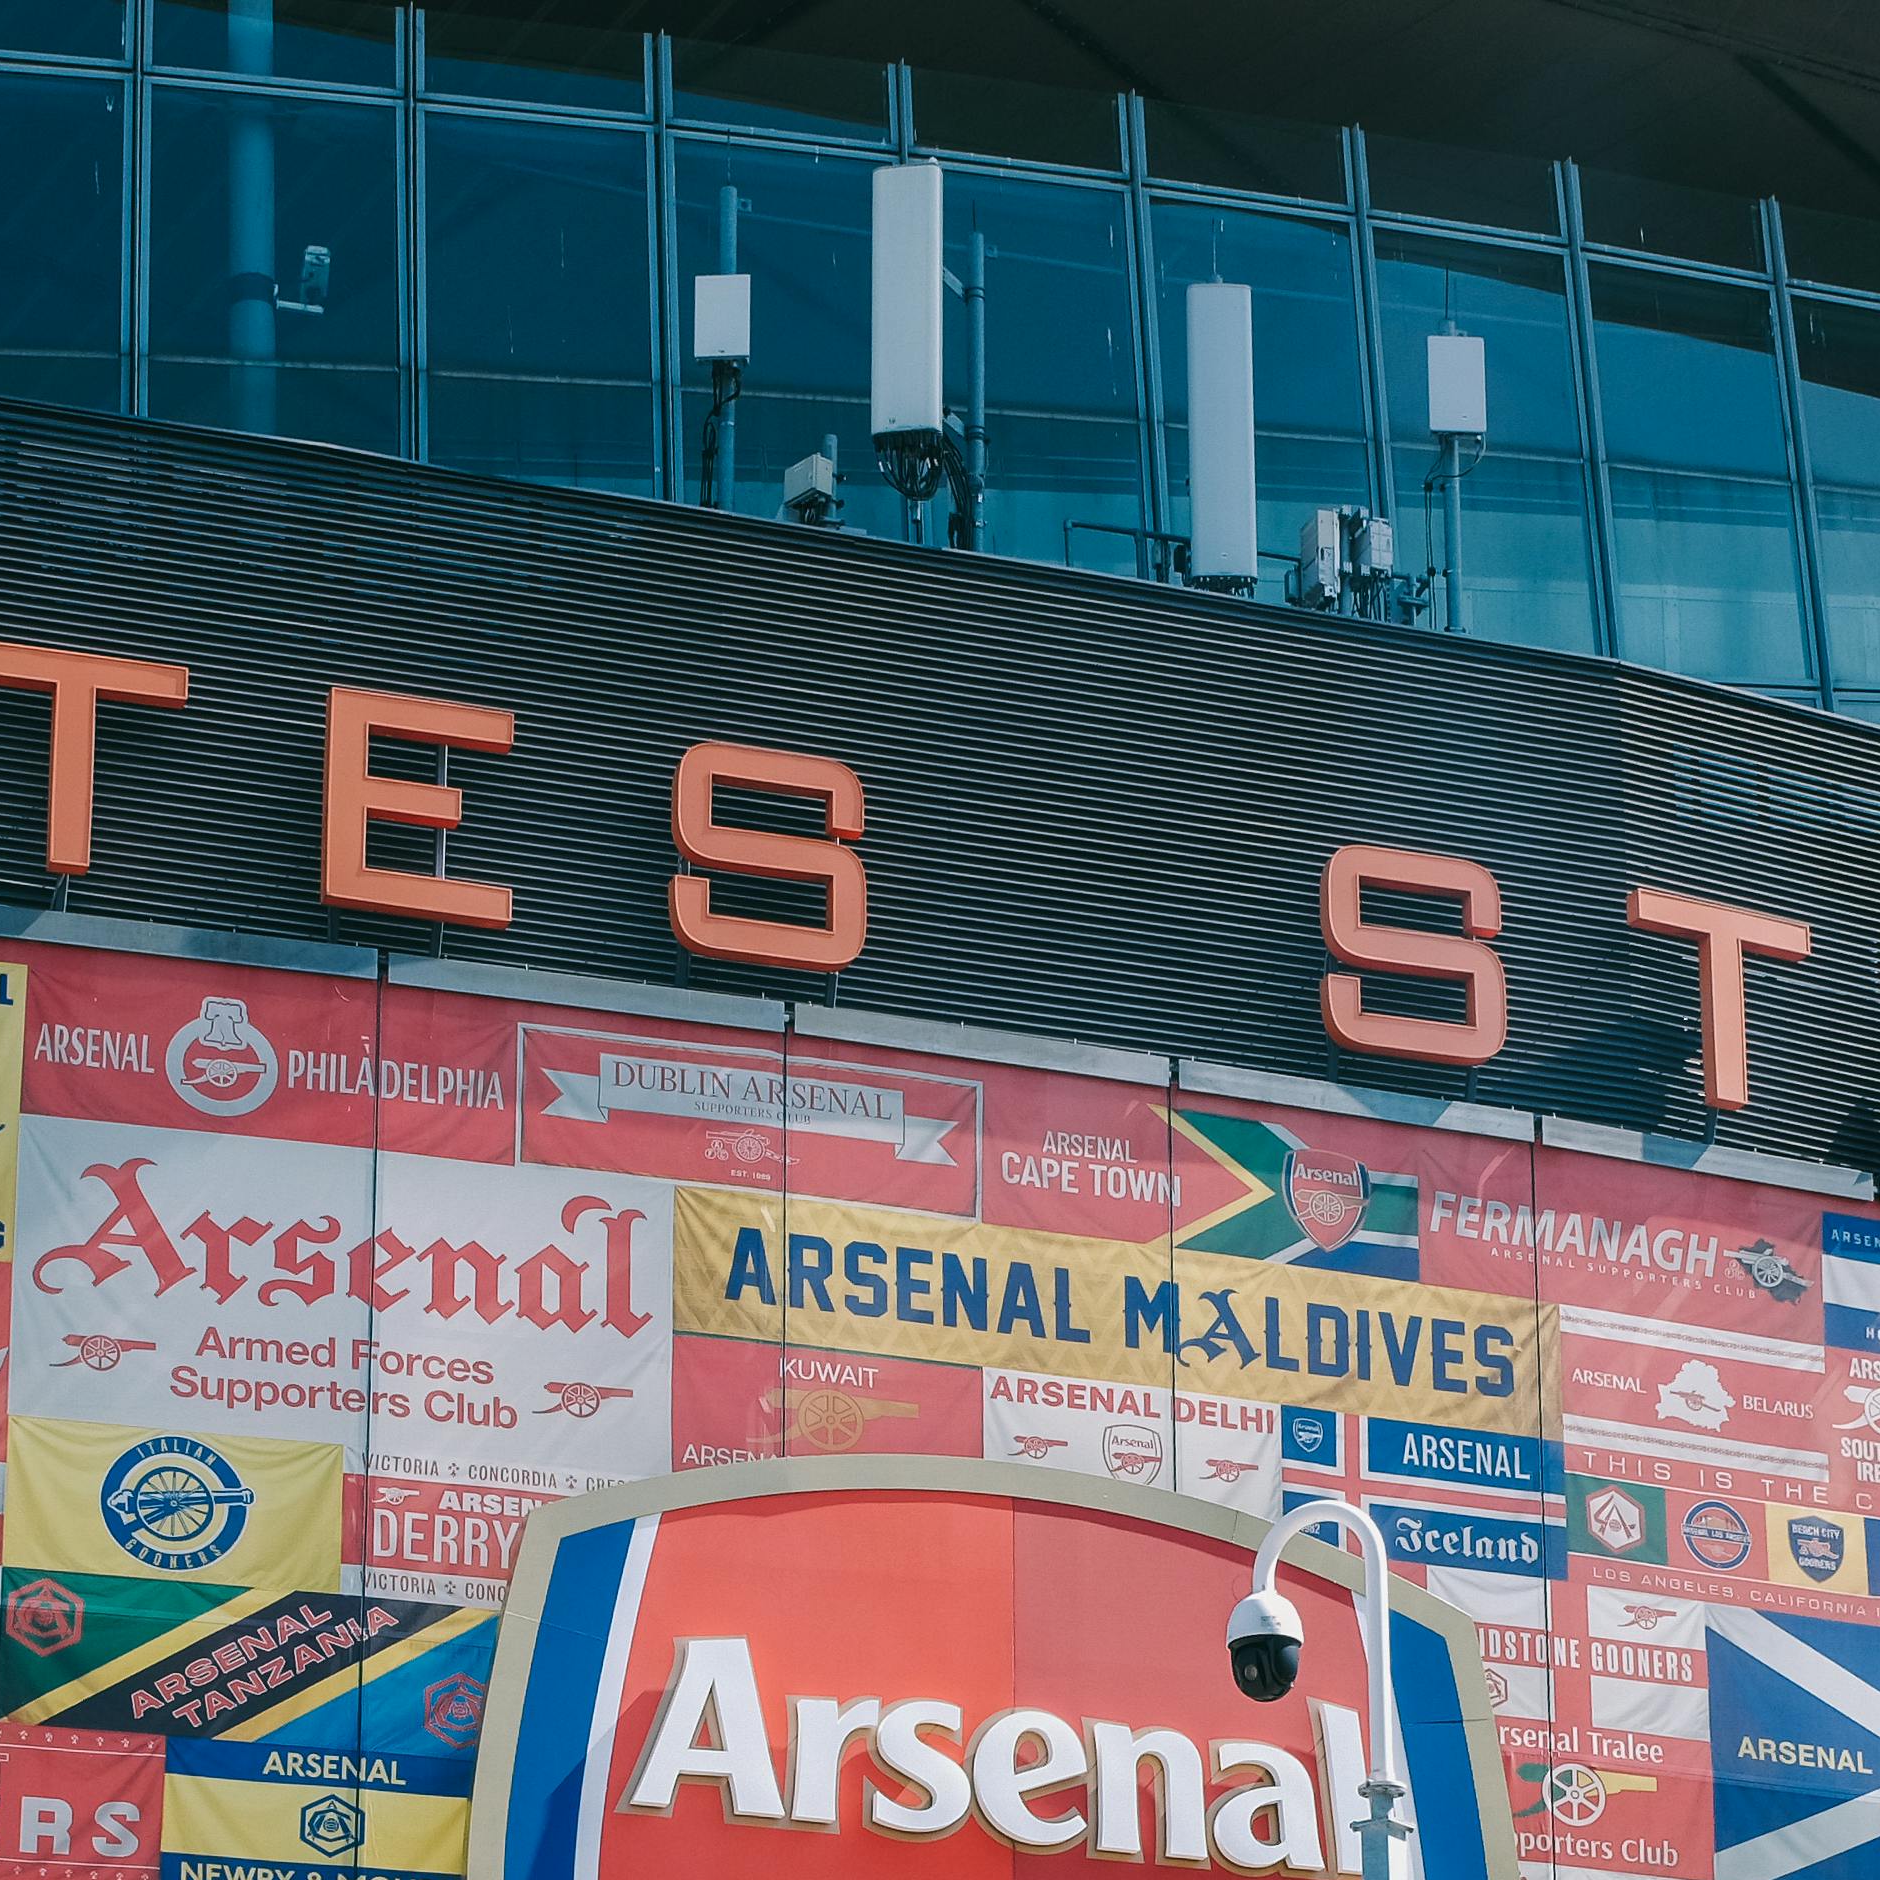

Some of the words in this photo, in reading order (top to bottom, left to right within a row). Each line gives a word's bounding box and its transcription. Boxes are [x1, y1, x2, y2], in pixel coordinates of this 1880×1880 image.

[34, 1022, 154, 1075] ARSENAL
[288, 1049, 504, 1111] PHILADELPHIA
[1042, 1129, 1138, 1161] ARSENAL
[1001, 1153, 1078, 1192] CAPE
[1086, 1164, 1181, 1206] TOWN
[32, 1156, 652, 1337] Arsenal
[1431, 1190, 1718, 1276] FERMANAGH
[724, 1226, 1091, 1344] ARSENAL
[1122, 1274, 1516, 1398] MALDIVES
[195, 1326, 332, 1367] Armed
[346, 1341, 494, 1384] Forces
[170, 1366, 410, 1418] Supporters
[424, 1392, 518, 1431] Club
[990, 1375, 1163, 1423] ARSENAL
[1173, 1396, 1276, 1433] DELHI
[1403, 1433, 1531, 1481] ARSENAL
[1395, 1515, 1541, 1565] Iceland
[628, 1636, 1370, 1875] Arsenal
[1737, 1736, 1872, 1776] ARSENAL
